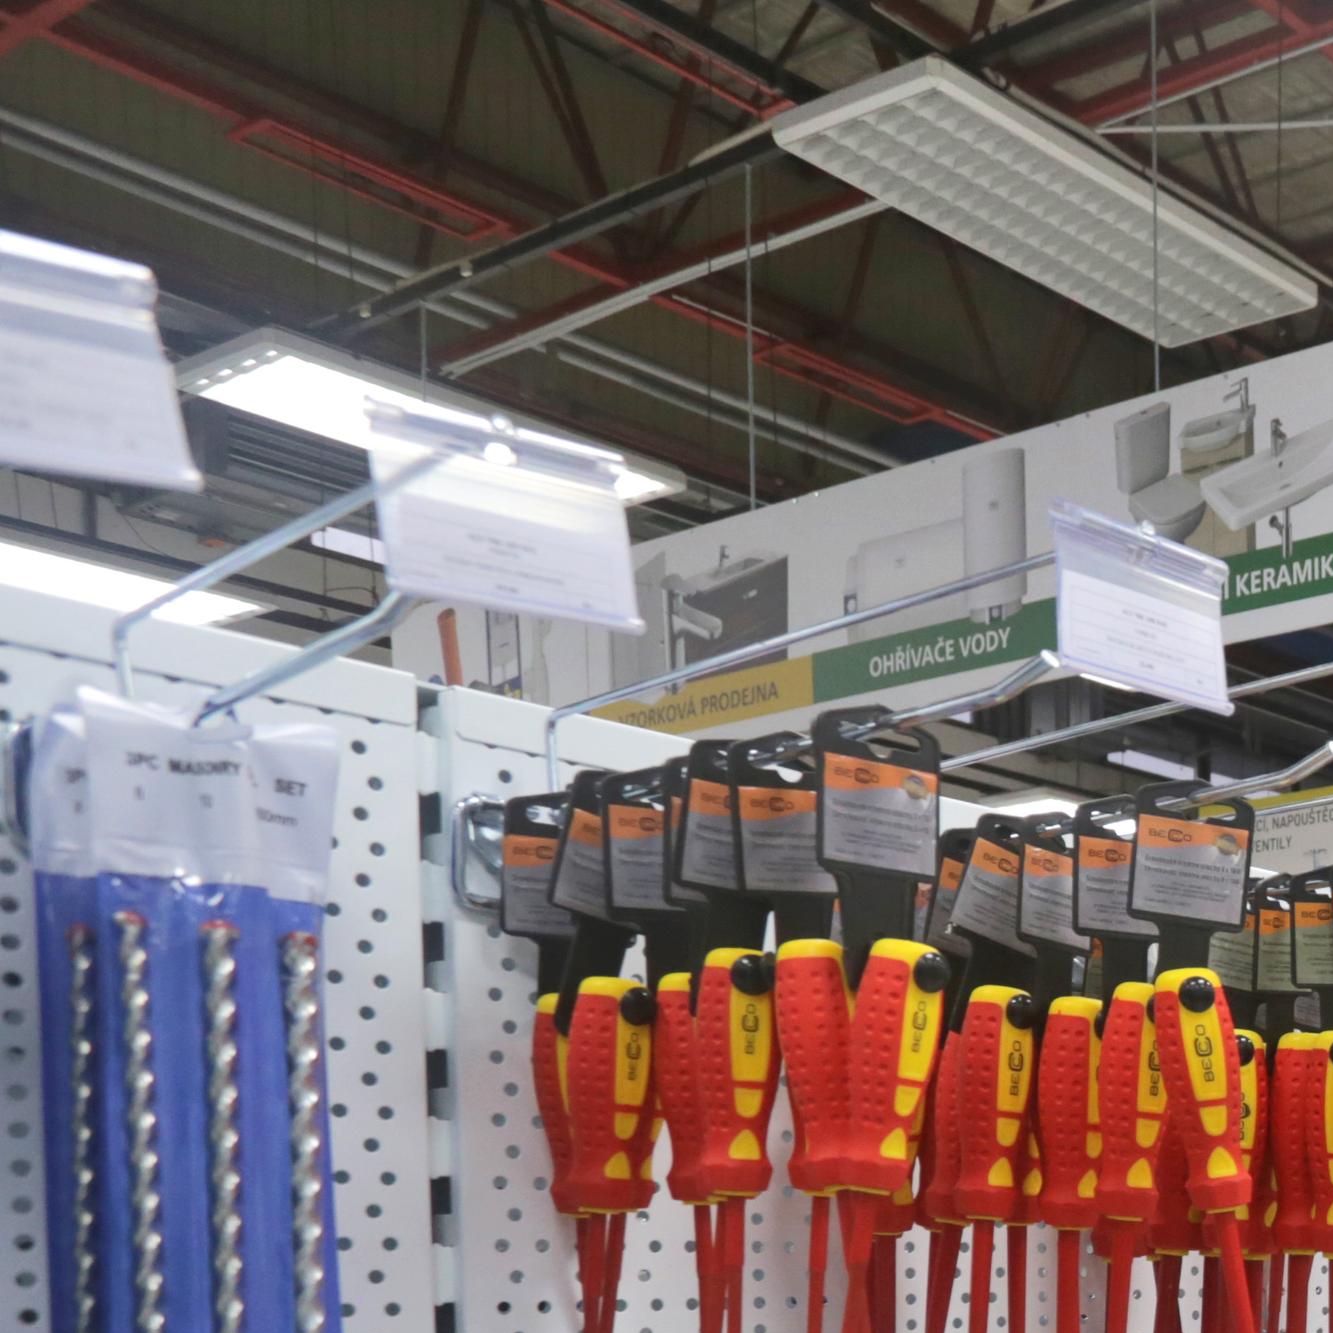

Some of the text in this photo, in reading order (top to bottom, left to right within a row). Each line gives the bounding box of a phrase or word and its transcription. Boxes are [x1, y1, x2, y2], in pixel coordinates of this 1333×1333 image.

[868, 627, 1012, 678] OHŘÍVAČE VODY
[701, 681, 779, 714] PRODEJNA
[1254, 836, 1293, 853] ENTILY
